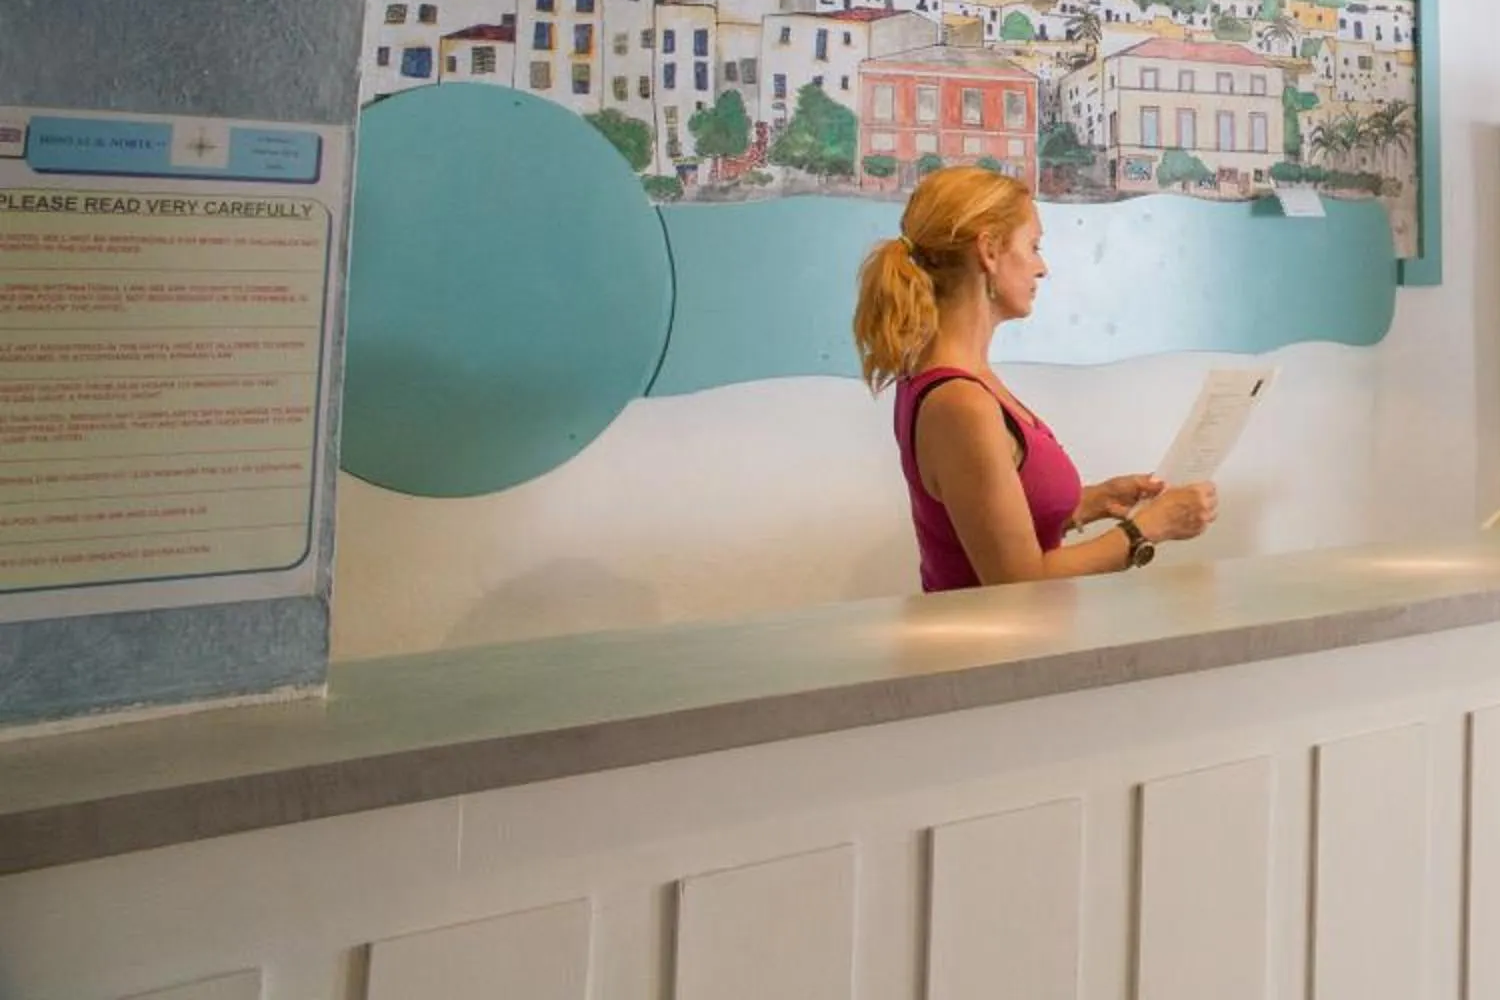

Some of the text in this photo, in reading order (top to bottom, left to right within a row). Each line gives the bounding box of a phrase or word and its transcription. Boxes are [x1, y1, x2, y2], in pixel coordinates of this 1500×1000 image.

[84, 197, 140, 214] READ
[147, 199, 198, 215] VERY
[203, 201, 312, 218] CAREFULLY
